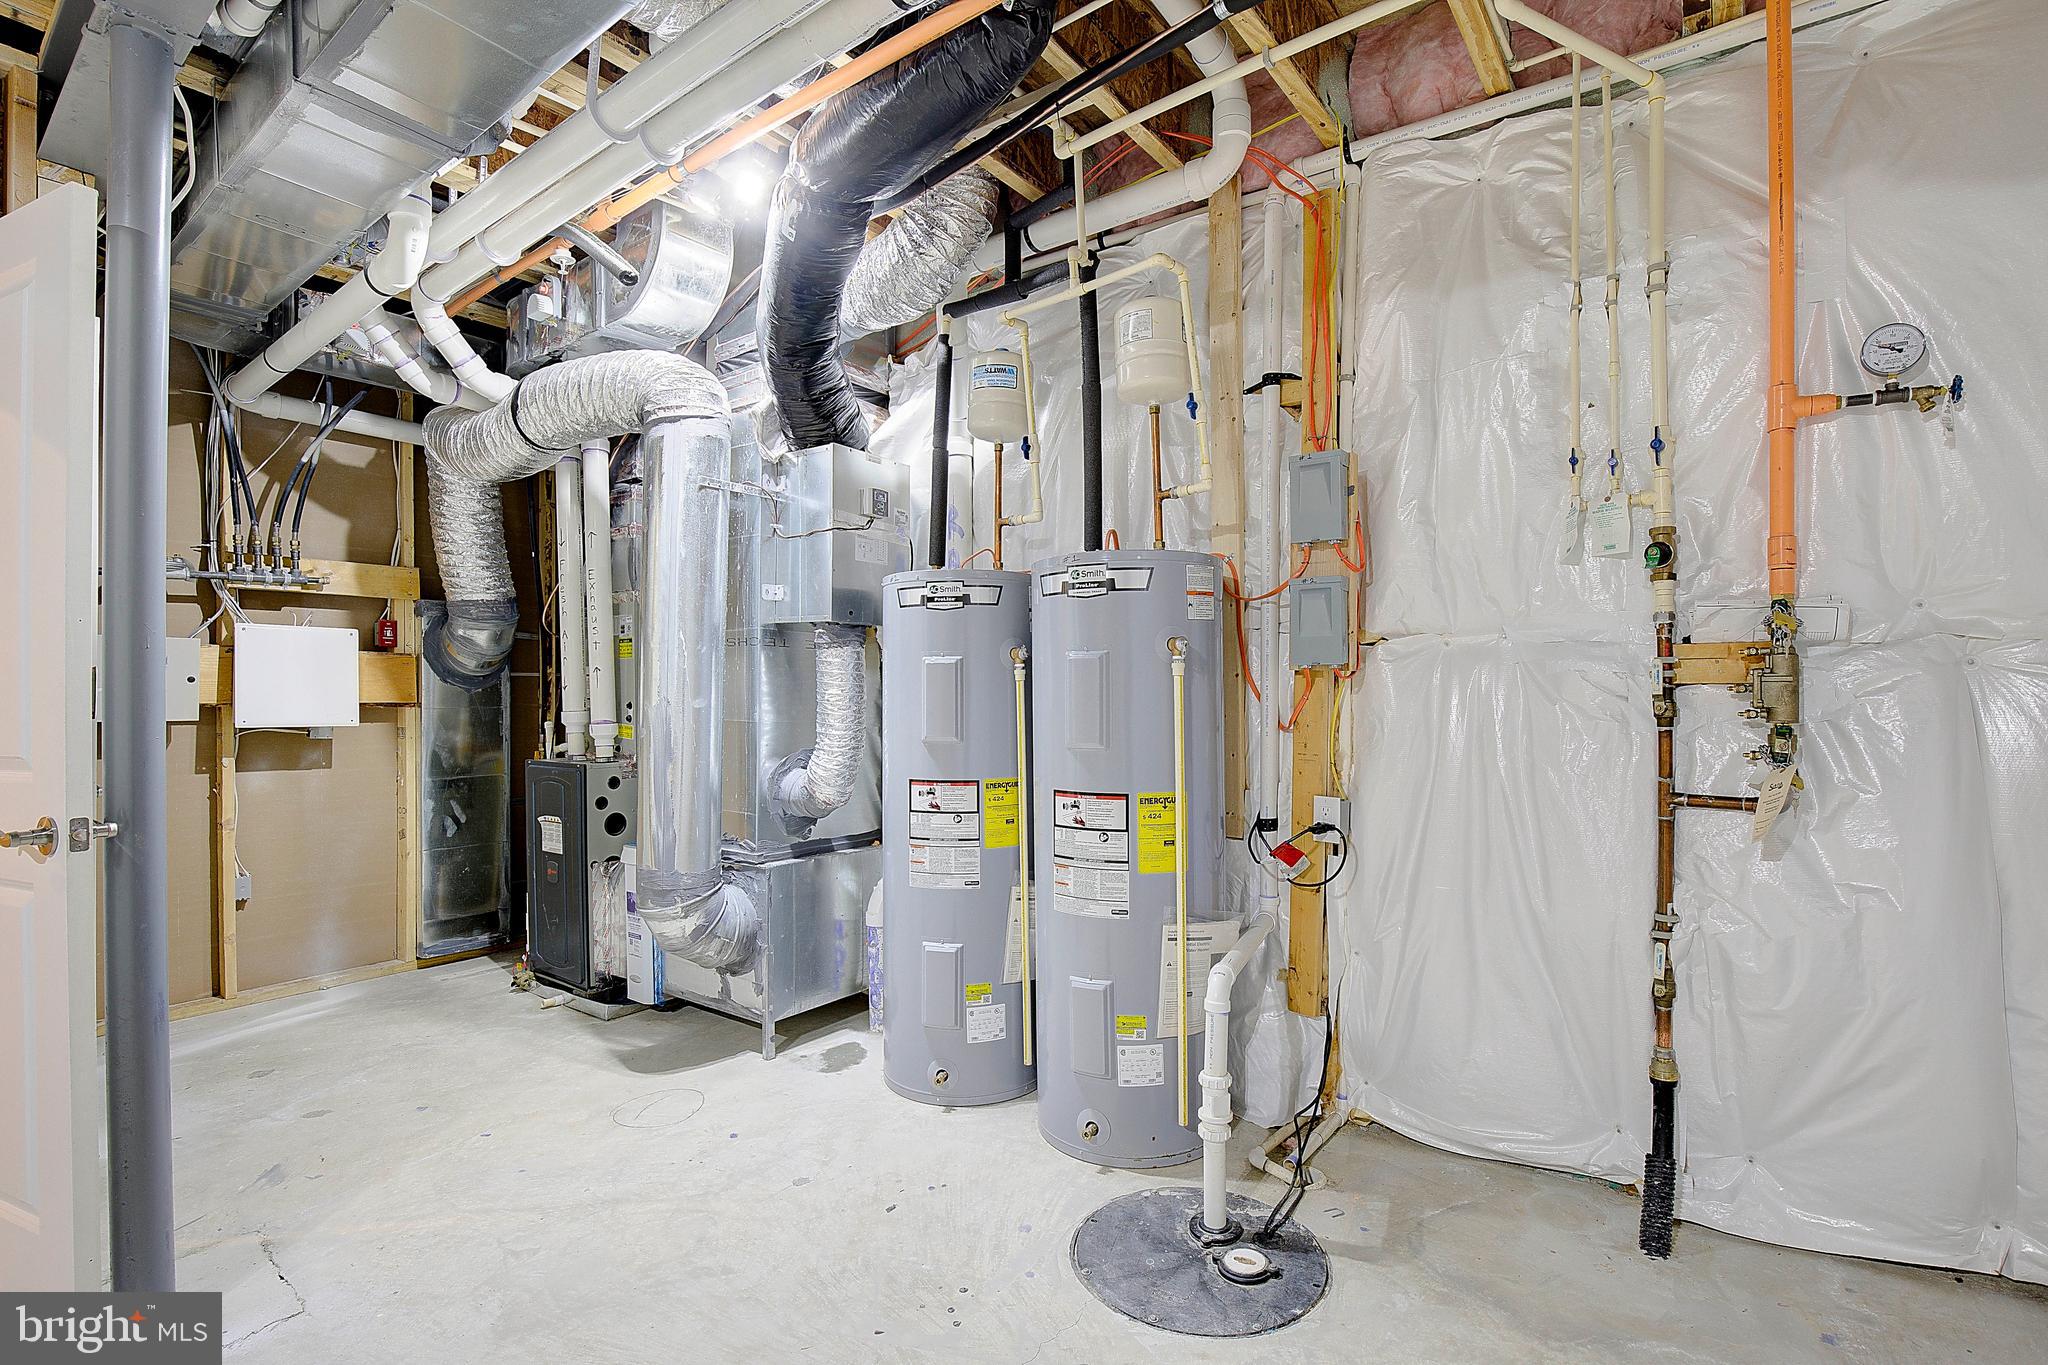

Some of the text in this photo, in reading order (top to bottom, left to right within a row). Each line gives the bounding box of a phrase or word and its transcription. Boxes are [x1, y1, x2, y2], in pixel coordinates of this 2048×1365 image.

[588, 569, 601, 651] Exhaust
[939, 585, 961, 593] Smith
[558, 559, 569, 667] Fresh Air
[1139, 796, 1176, 808] ENERGYGU
